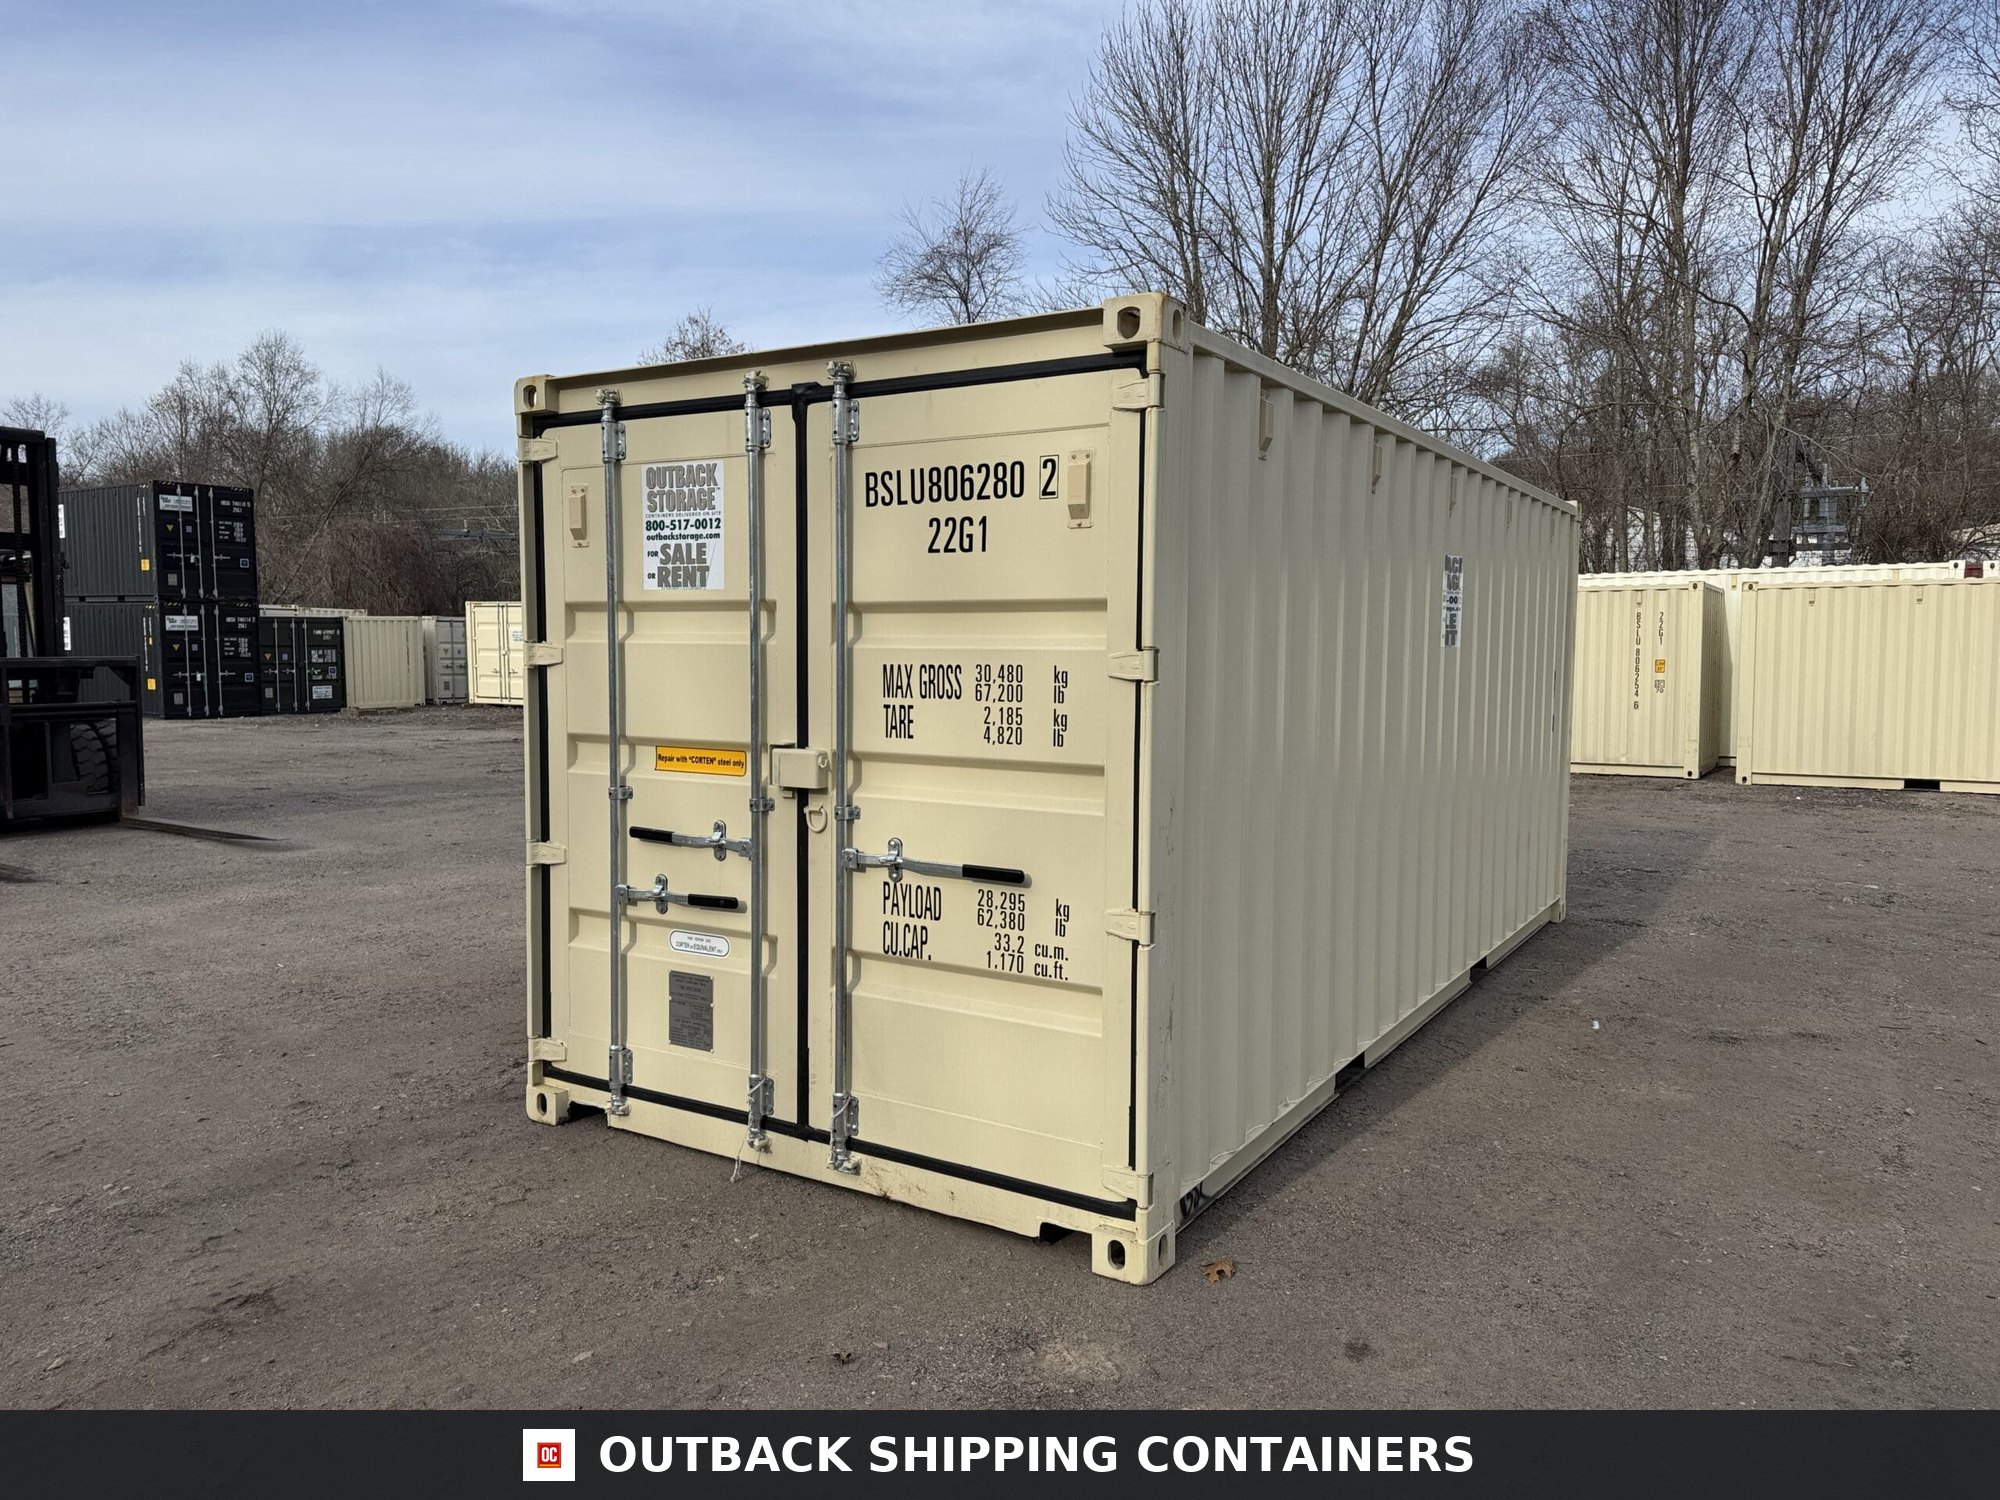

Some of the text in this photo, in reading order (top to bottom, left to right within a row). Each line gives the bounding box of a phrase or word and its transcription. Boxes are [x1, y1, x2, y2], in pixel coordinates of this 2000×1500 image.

[646, 463, 718, 489] OUTBACK
[865, 458, 1057, 507] BSLU806280 2
[647, 487, 716, 512] STORAGE
[646, 518, 721, 531] 800-517-0012
[646, 532, 720, 541] outbackstorage.com
[928, 516, 987, 553] 22G1
[660, 543, 707, 565] SALE
[658, 566, 710, 588] RENT
[883, 664, 1068, 700] MAX GROSS 30,480 kg
[975, 684, 1064, 704] 67,200 lb
[883, 704, 1068, 739] TARE 2,185 kg
[984, 726, 1064, 748] 4,820 lb
[658, 754, 674, 763] Repair
[676, 755, 688, 763] with
[718, 758, 731, 766] steel
[732, 760, 744, 768] only
[882, 881, 1070, 922] PAYLOAD 28,295 kg
[977, 908, 1066, 938] 62,380 lb
[882, 921, 1069, 961] CU.CAP. 33.2 cu.m.
[986, 950, 1068, 980] 1,170 cu.ft.
